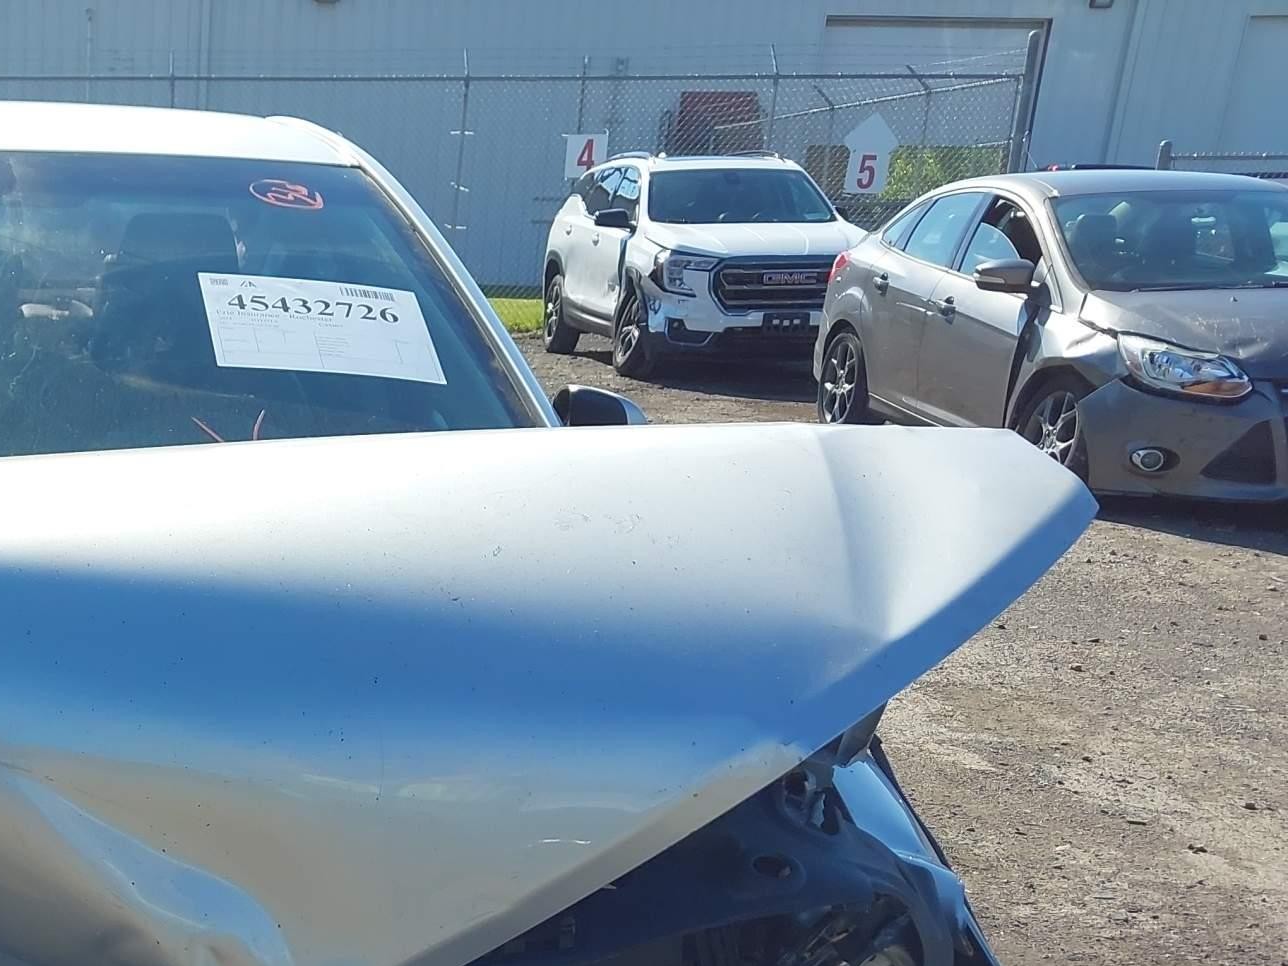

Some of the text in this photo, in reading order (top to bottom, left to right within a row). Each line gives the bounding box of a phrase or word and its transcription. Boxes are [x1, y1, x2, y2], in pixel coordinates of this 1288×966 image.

[577, 139, 594, 171] 4
[856, 155, 876, 189] 5
[763, 272, 817, 285] GMC
[227, 294, 399, 323] 45432726
